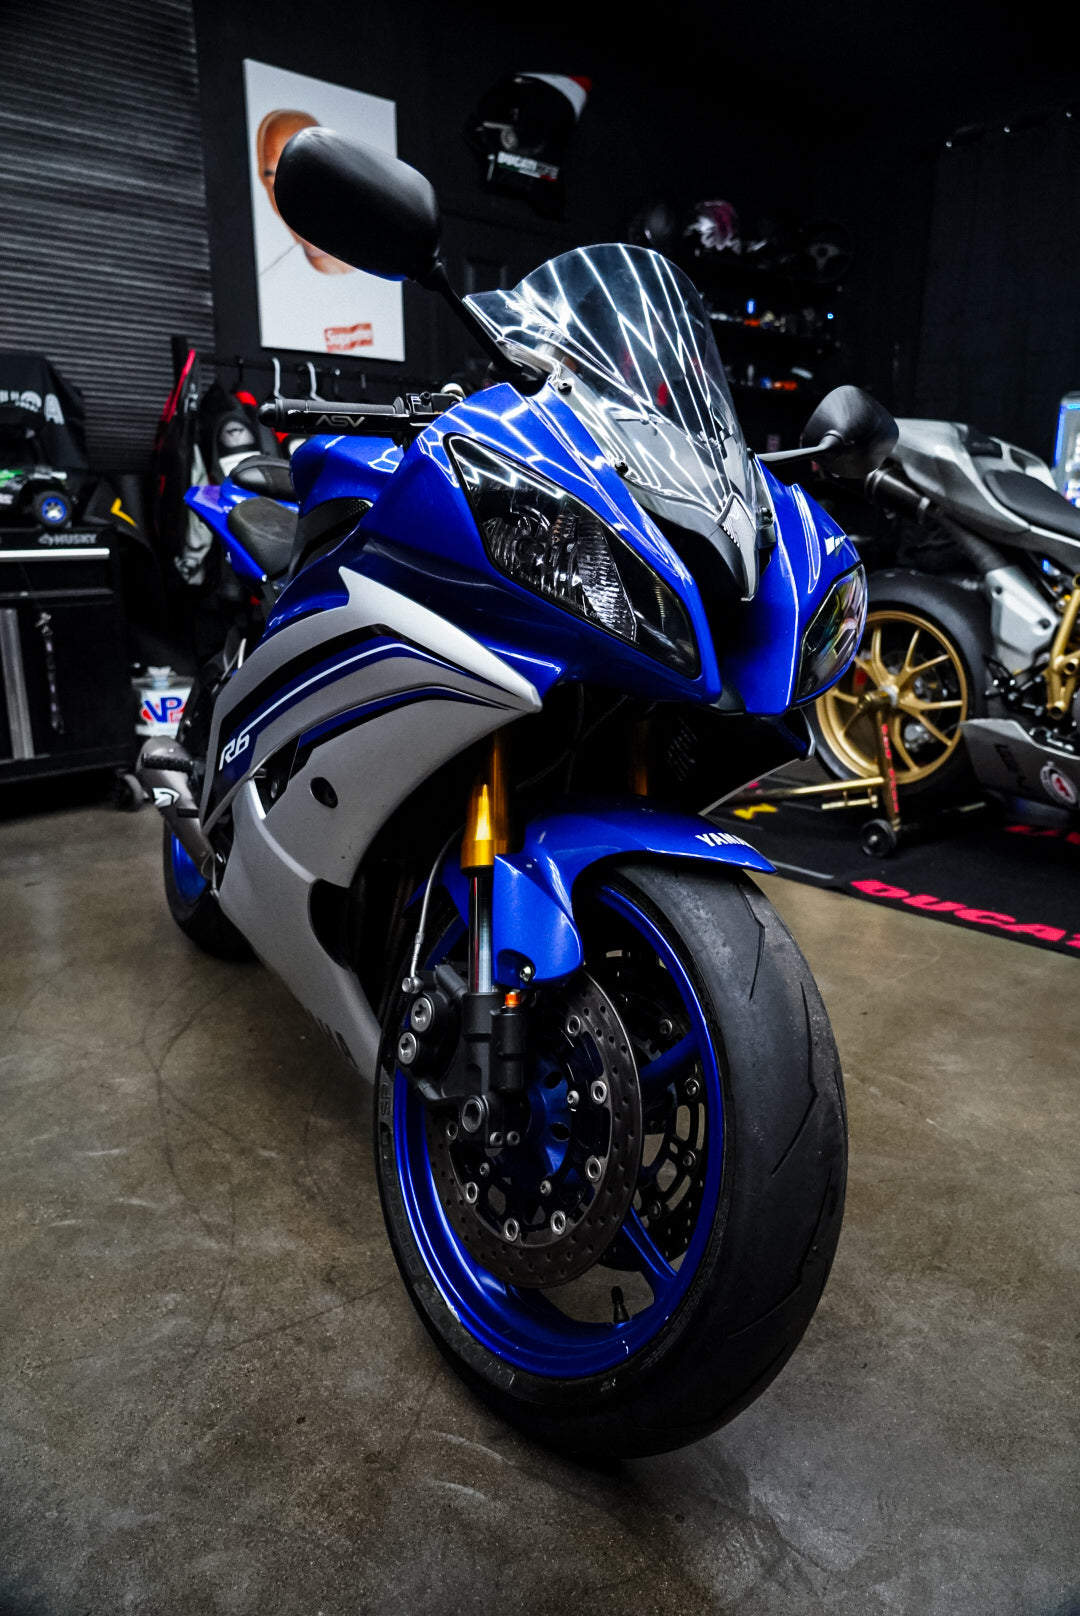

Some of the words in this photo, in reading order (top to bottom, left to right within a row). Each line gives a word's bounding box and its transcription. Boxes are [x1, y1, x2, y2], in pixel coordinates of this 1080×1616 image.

[314, 414, 366, 428] ASV
[54, 533, 97, 545] HUSKY
[144, 697, 182, 722] VP
[218, 734, 250, 771] R6
[850, 879, 1080, 949] DUCA
